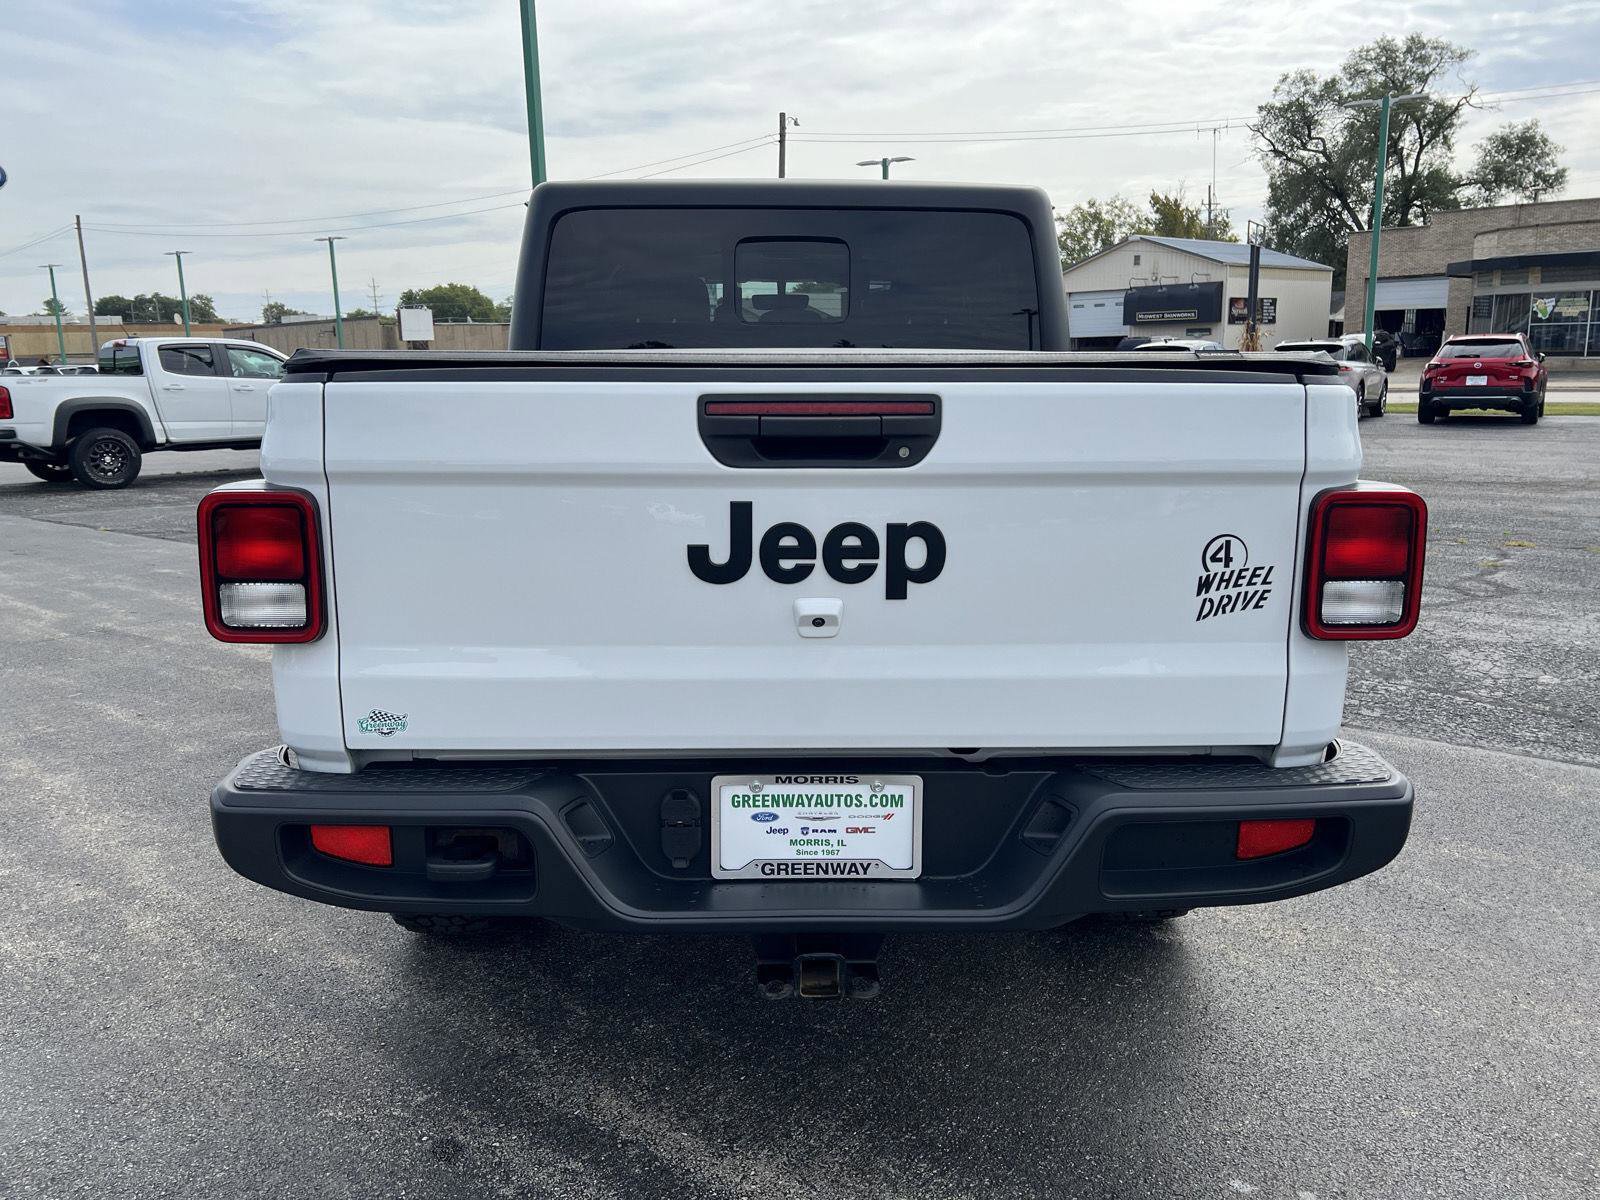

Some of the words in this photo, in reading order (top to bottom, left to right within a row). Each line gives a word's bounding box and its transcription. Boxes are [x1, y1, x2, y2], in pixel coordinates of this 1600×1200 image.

[687, 501, 946, 600] Jeep
[1209, 540, 1233, 568] 4
[1196, 566, 1274, 597] WHEEL
[1196, 589, 1272, 621] DRIVE
[358, 718, 407, 731] Greenway
[775, 775, 860, 785] MORRIS
[731, 793, 904, 808] GREENWAYAUTOS.COM
[766, 826, 789, 835] Jeep
[789, 839, 834, 848] MORRIS,
[837, 839, 847, 847] IL
[796, 848, 819, 856] Since
[760, 862, 872, 876] GREENWAY
